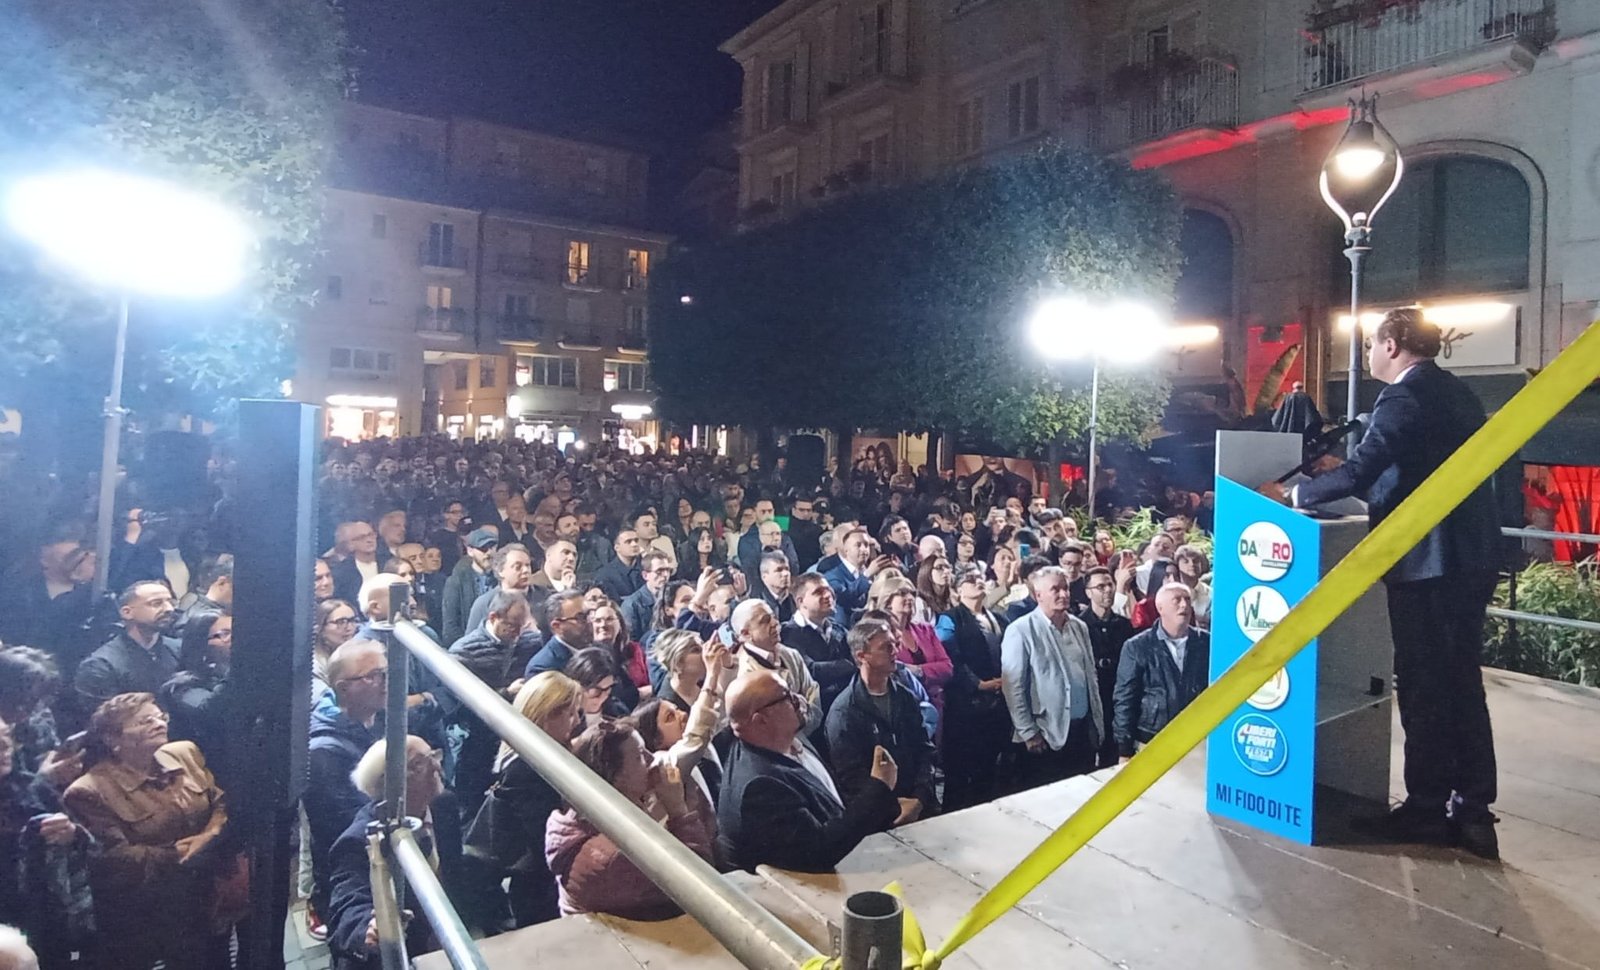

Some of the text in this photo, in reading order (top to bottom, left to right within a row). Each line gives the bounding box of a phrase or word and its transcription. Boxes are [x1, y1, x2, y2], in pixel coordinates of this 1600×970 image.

[1216, 783, 1301, 827] MI FIDO DI TE
